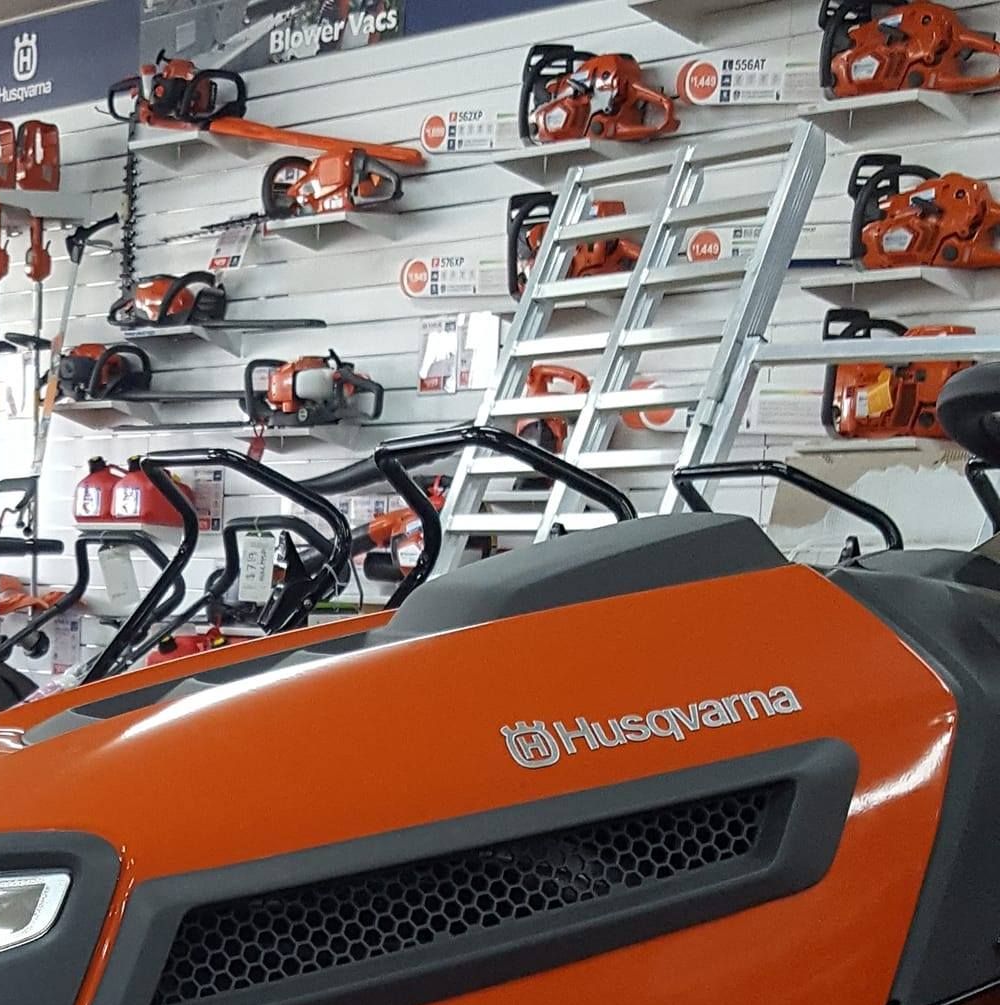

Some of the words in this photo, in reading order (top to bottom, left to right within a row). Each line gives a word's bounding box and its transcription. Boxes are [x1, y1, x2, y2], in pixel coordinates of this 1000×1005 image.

[269, 20, 345, 55] Blower
[349, 8, 398, 36] Vacs
[734, 58, 767, 71] 556AT
[552, 685, 802, 755] Husqvarna
